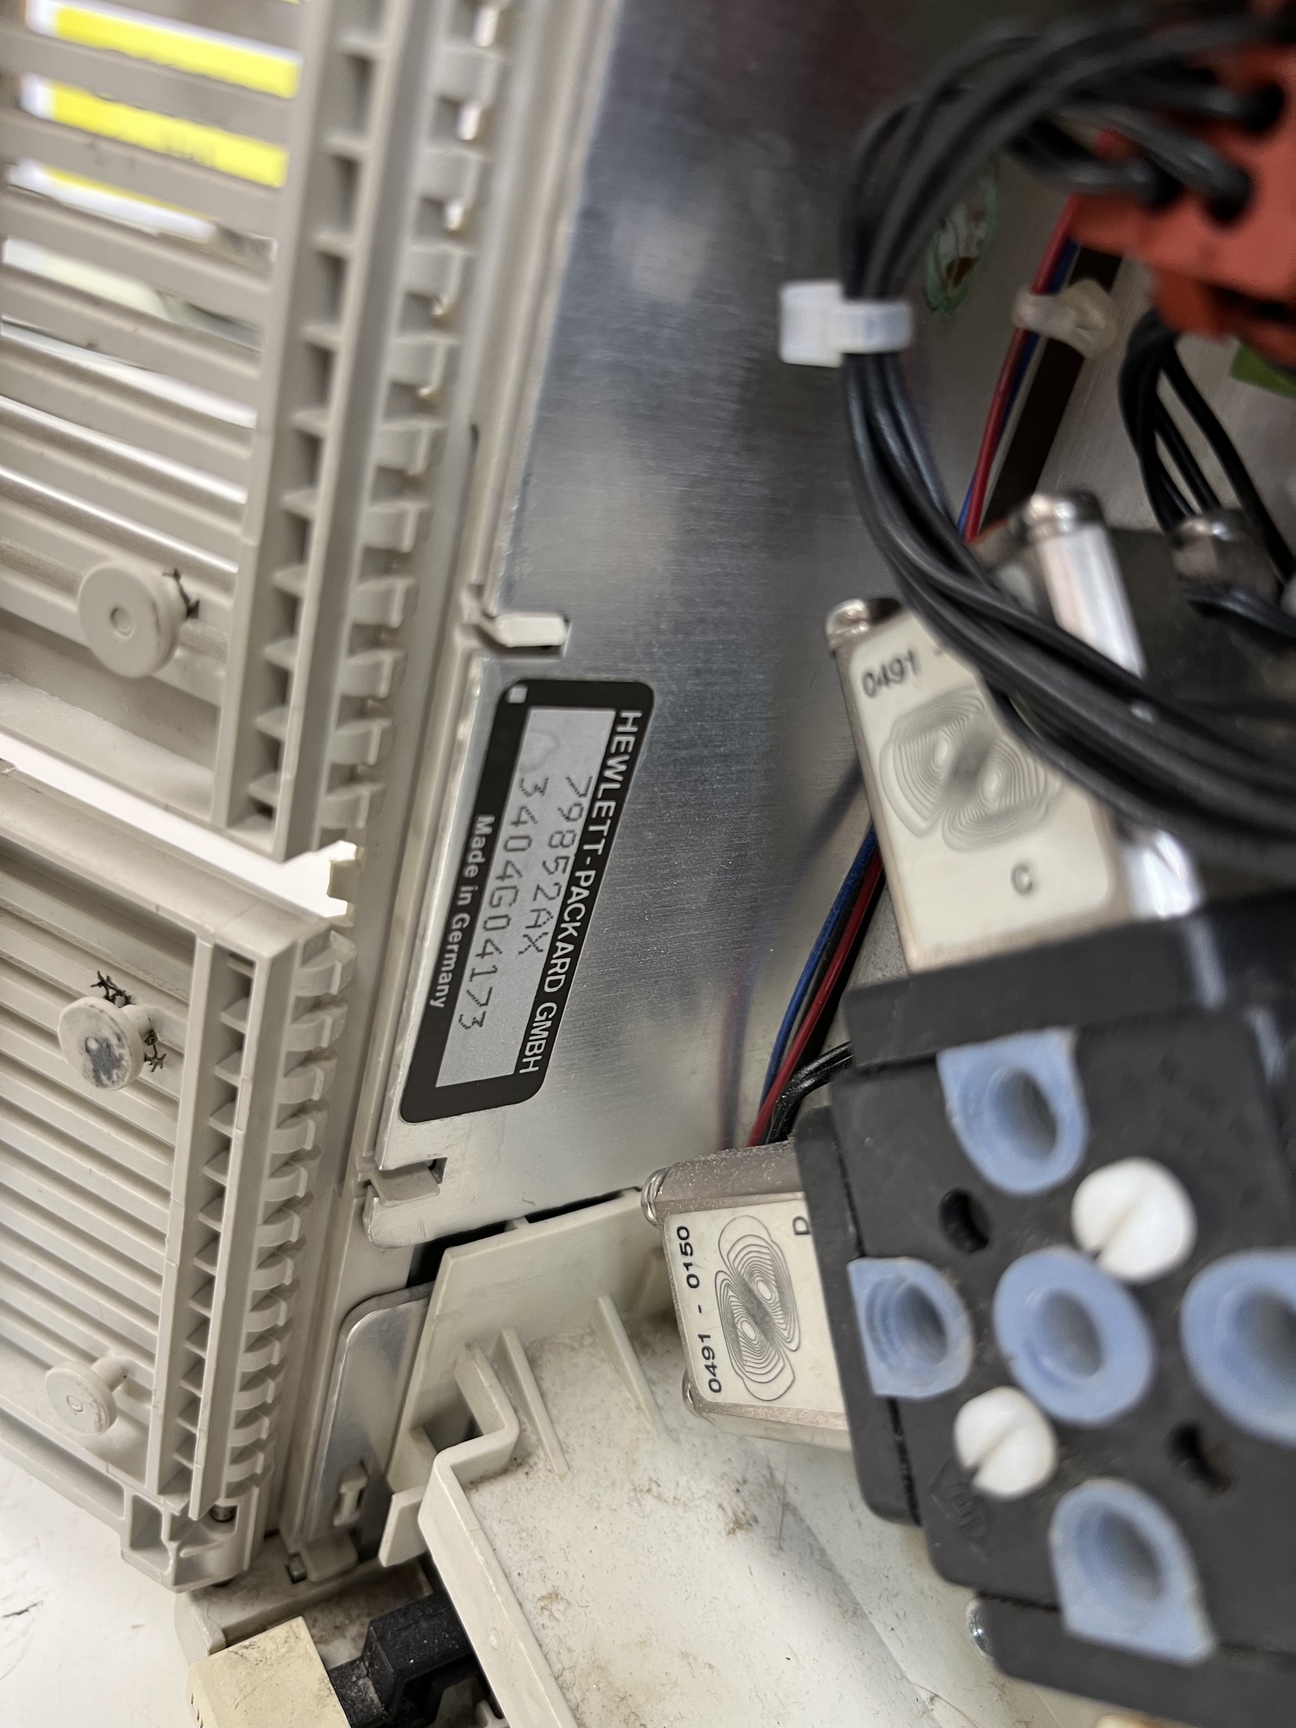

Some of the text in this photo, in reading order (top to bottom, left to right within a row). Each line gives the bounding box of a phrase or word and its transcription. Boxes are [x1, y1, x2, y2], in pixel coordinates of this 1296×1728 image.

[862, 651, 919, 698] 0491
[429, 815, 495, 1008] Made in Germany
[458, 777, 548, 1030] 3404G04173
[519, 776, 593, 955] 79852AX
[520, 710, 643, 1073] HEWLETT-PACKARD GMBH
[677, 1226, 700, 1288] 0150
[698, 1334, 722, 1393] 0491
